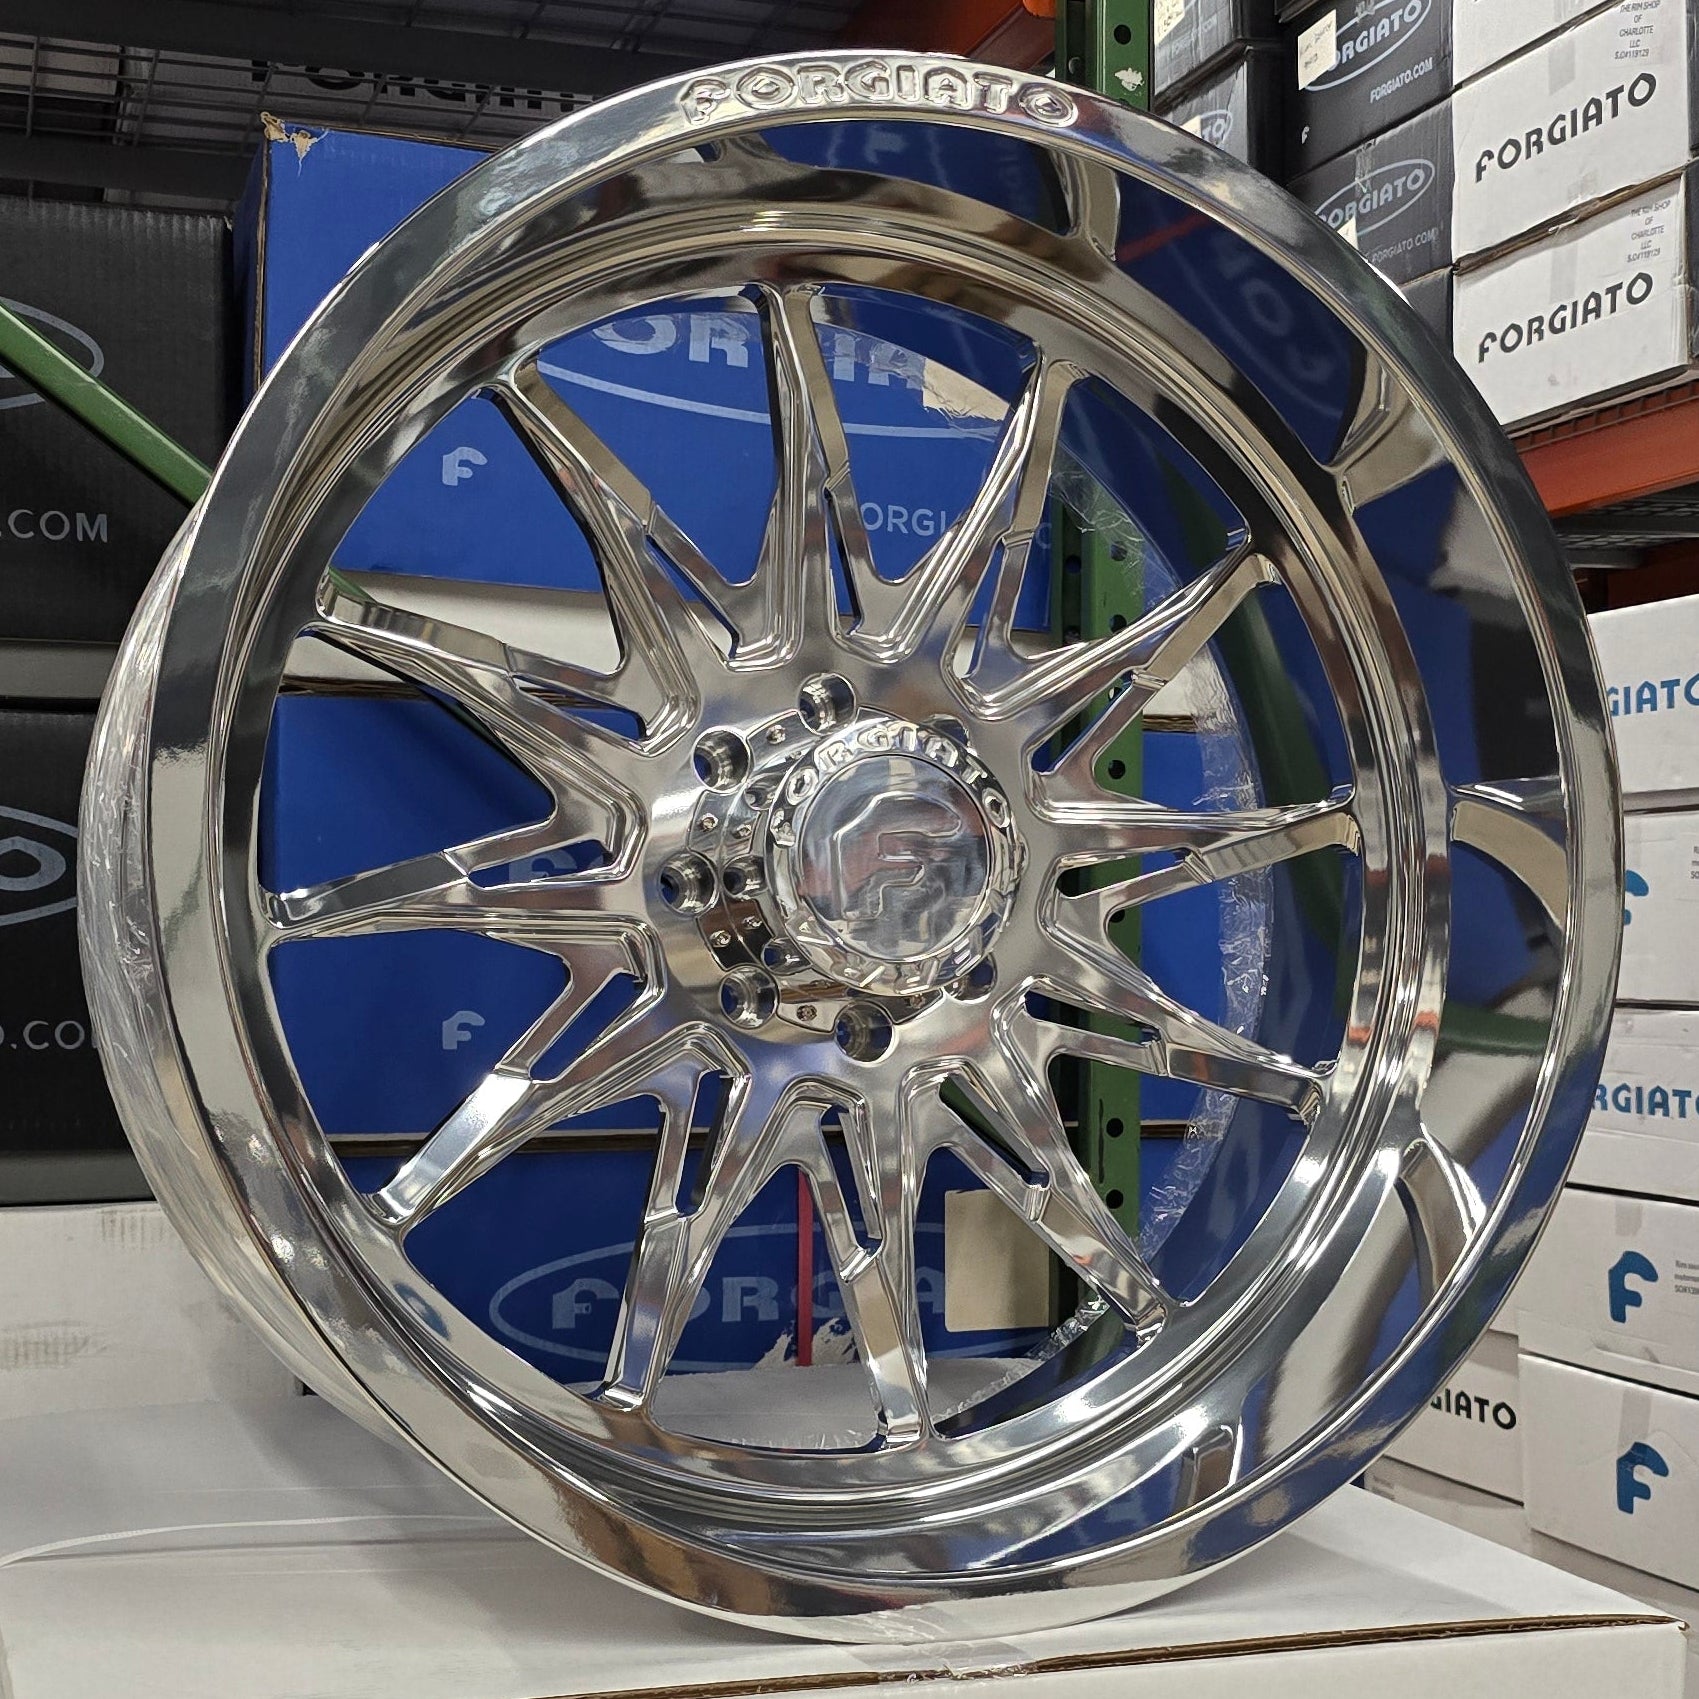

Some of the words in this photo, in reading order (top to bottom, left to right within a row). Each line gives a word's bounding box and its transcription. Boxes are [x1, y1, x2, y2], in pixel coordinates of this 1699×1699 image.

[1619, 25, 1654, 37] CHARLOTTE
[1629, 39, 1641, 48] LLC
[678, 58, 1079, 128] FORGIATO
[1370, 56, 1433, 104] FORGIATO.COM
[1475, 72, 1657, 183] FORGIATO
[1478, 272, 1654, 364] FORGIATO
[1592, 1083, 1699, 1119] RGIAT
